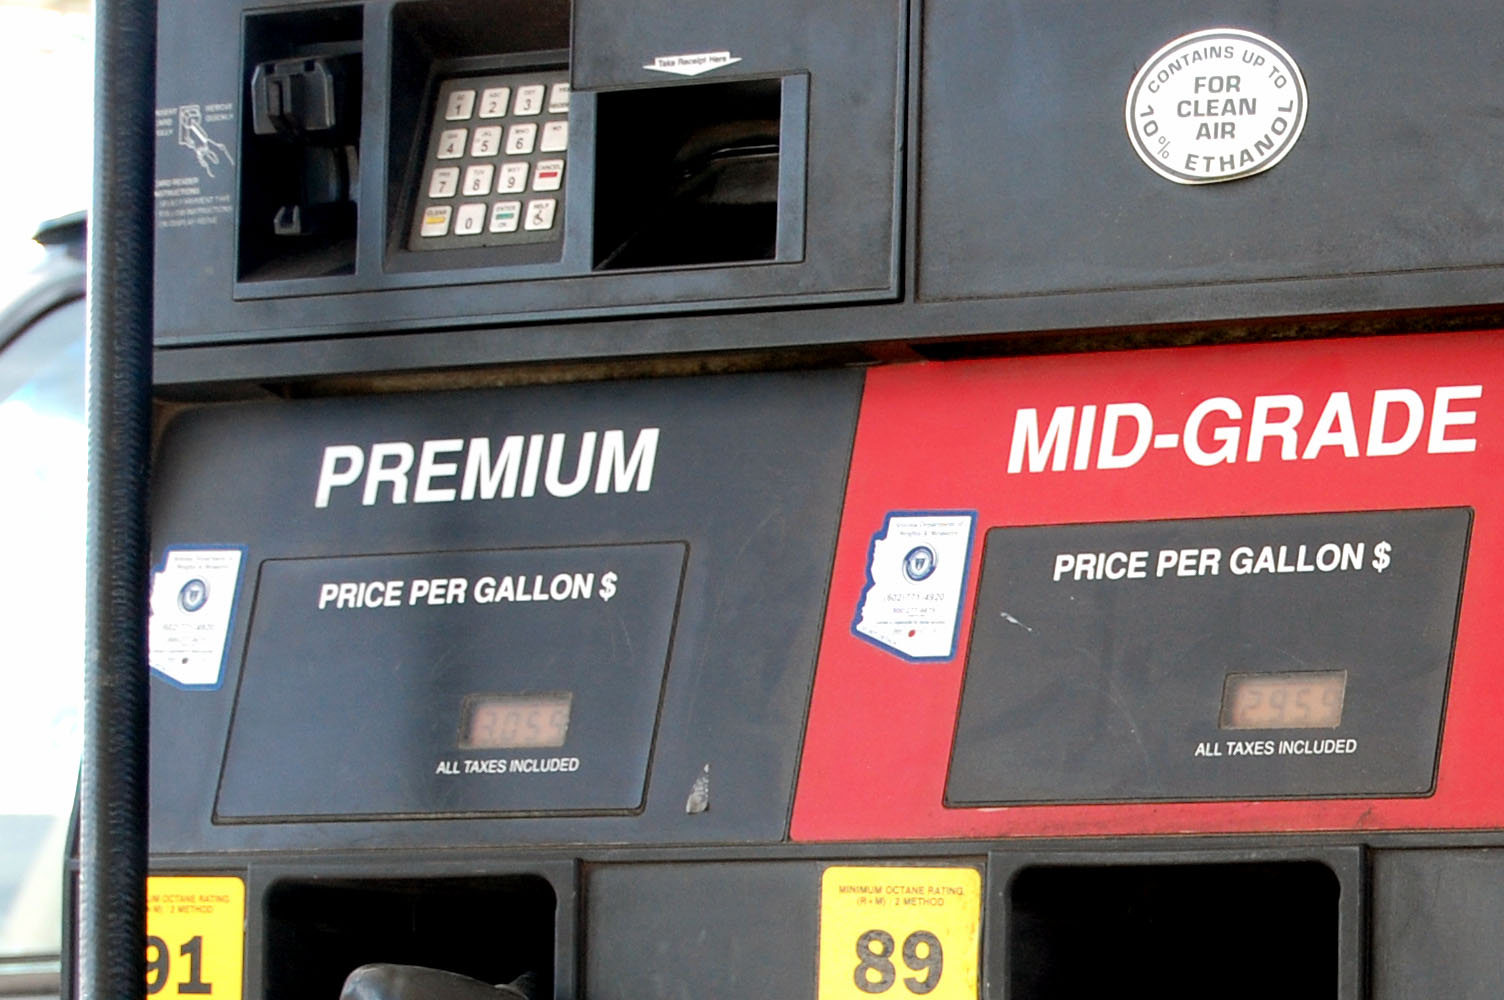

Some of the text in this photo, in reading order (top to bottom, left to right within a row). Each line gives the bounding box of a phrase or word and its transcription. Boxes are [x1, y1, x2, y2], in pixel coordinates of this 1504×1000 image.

[658, 55, 727, 67] Take Receipt Here
[1148, 46, 1287, 94] CONTAINS UP TO
[1194, 75, 1241, 94] FOR
[455, 105, 462, 115] 1
[489, 102, 497, 113] 2
[523, 98, 532, 111] 3
[1176, 98, 1257, 118] CLEAN
[1184, 100, 1294, 172] ETHANOL
[1195, 122, 1236, 140] AIR
[447, 143, 454, 153] 4
[480, 140, 489, 152] 5
[515, 138, 524, 150] 6
[439, 181, 447, 192] 7
[472, 179, 480, 191] 8
[507, 176, 516, 189] 9
[465, 218, 473, 230] 0
[1006, 384, 1483, 474] MID-GRADE
[314, 427, 660, 509] PREMIUM
[1053, 541, 1392, 582] PRICE PER GALLON $
[318, 571, 618, 610] PRICE PER GALLON $
[1194, 739, 1358, 757] ALL TAXES INCLUDED
[435, 757, 580, 774] ALL TAXES INCLUDED
[838, 885, 964, 896] MINIMUM OCTANE RATING
[903, 897, 945, 907] METHOD
[147, 935, 212, 995] 91
[853, 929, 944, 995] 89
